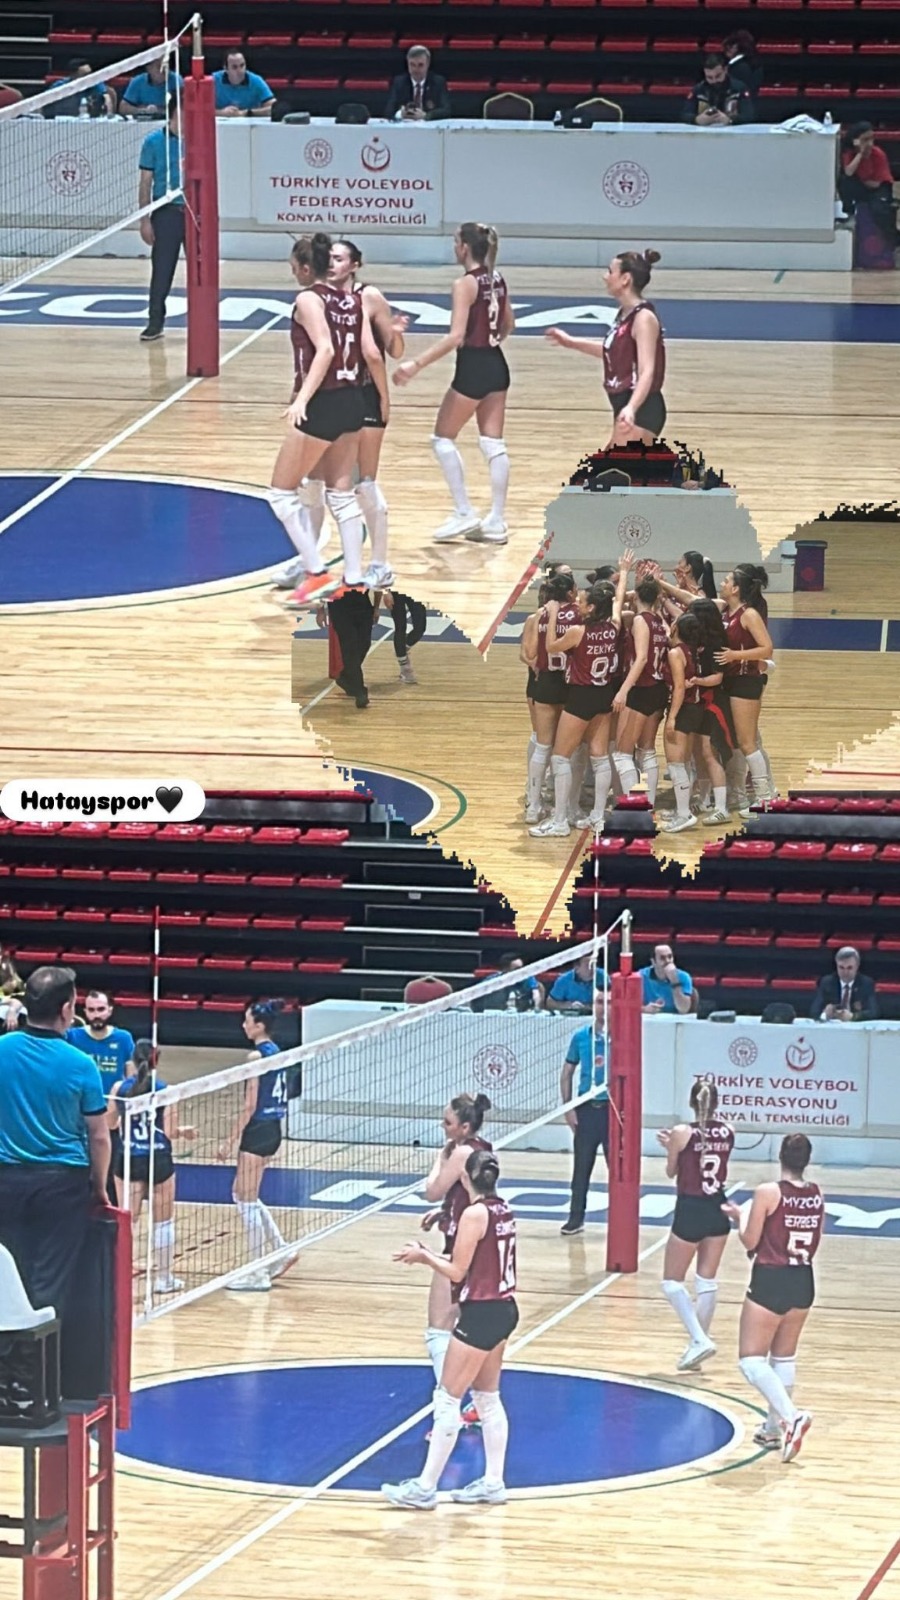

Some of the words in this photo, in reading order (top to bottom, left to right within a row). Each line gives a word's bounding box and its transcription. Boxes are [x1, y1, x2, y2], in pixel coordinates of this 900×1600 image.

[269, 174, 340, 189] TÜRKİYE
[345, 178, 434, 191] VOLEYBOL
[289, 195, 414, 210] FEDERASYONU
[277, 212, 323, 222] KONYA
[328, 211, 338, 223] İL
[343, 212, 427, 225] TEMSİLCİLİĞİ
[590, 656, 609, 686] 9
[769, 1078, 858, 1092] VOLEYBOL
[717, 1094, 838, 1109] EDERASYONU
[750, 1111, 761, 1123] İL
[766, 1113, 850, 1126] TEMSİLCİLİĞİ
[701, 1154, 721, 1195] 3
[782, 1194, 823, 1209] MYZCO
[787, 1230, 813, 1265] 5
